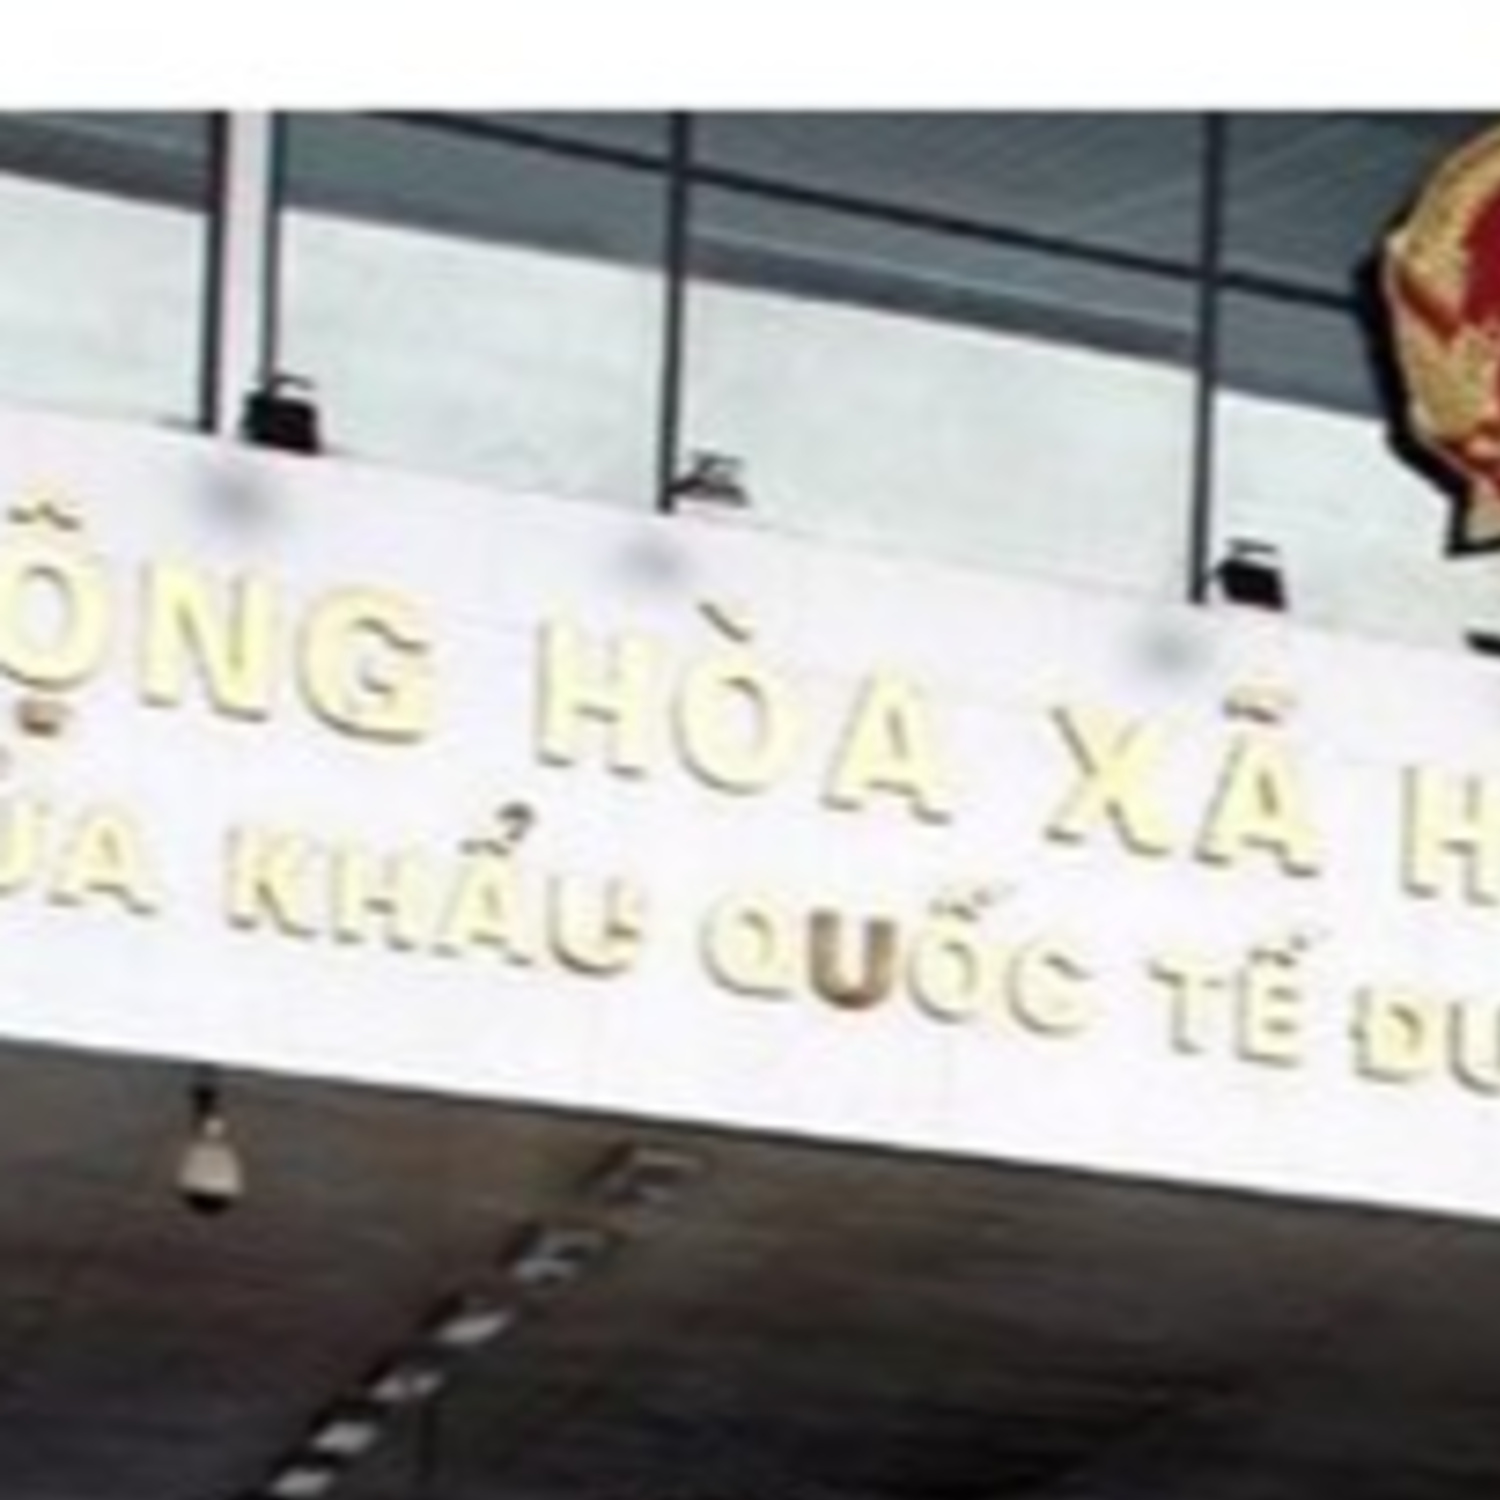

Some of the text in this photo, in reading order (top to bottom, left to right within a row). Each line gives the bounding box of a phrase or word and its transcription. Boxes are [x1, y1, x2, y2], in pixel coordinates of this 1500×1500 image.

[533, 598, 955, 826] HÒA
[1042, 682, 1321, 879] XÃ
[222, 801, 645, 980] KHẨU
[695, 883, 1094, 1036] QUỐC
[1145, 932, 1322, 1069] TẾ
